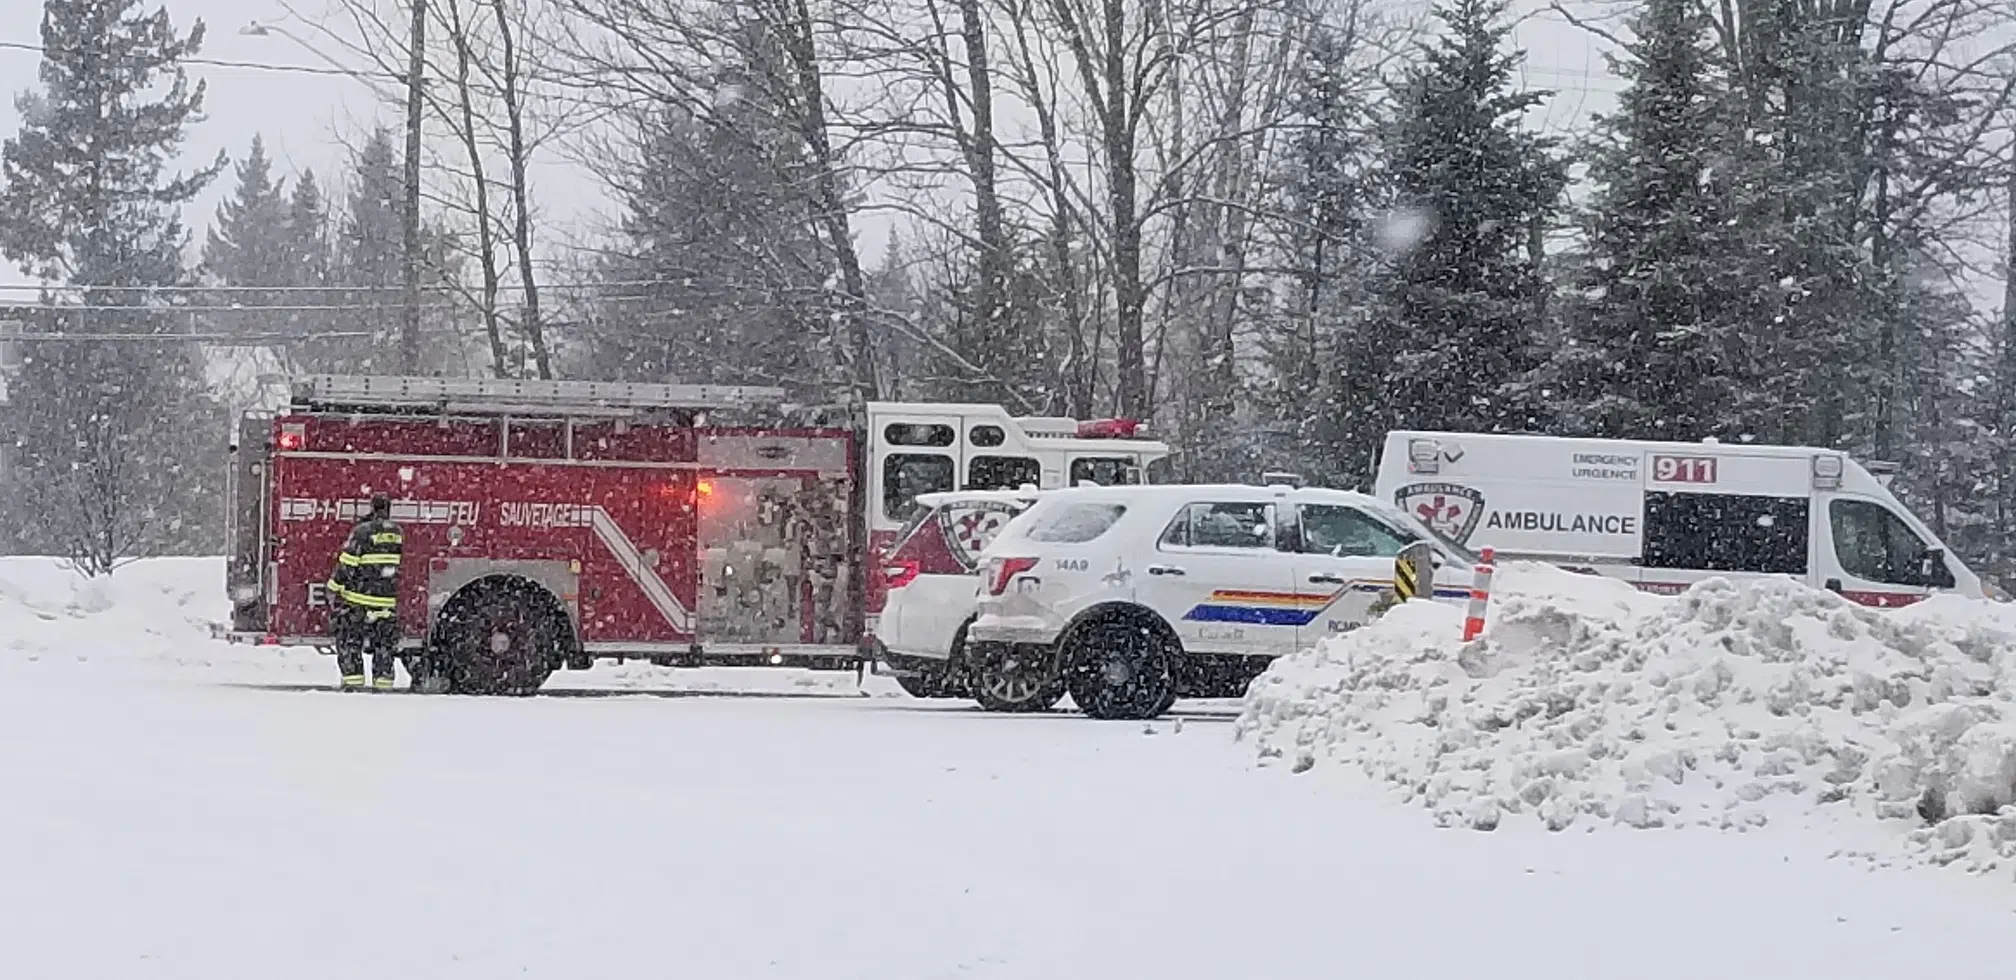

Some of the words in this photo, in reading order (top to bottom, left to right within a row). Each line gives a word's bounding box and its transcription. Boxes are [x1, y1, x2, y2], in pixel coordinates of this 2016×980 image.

[1573, 453, 1638, 466] EMERGENCY
[1572, 468, 1637, 481] URGENCE
[1657, 458, 1713, 482] 911
[448, 501, 480, 525] FEU
[500, 502, 571, 527] SAUVETAGE
[1487, 511, 1635, 534] AMBULANCE
[1056, 559, 1089, 571] 14A9
